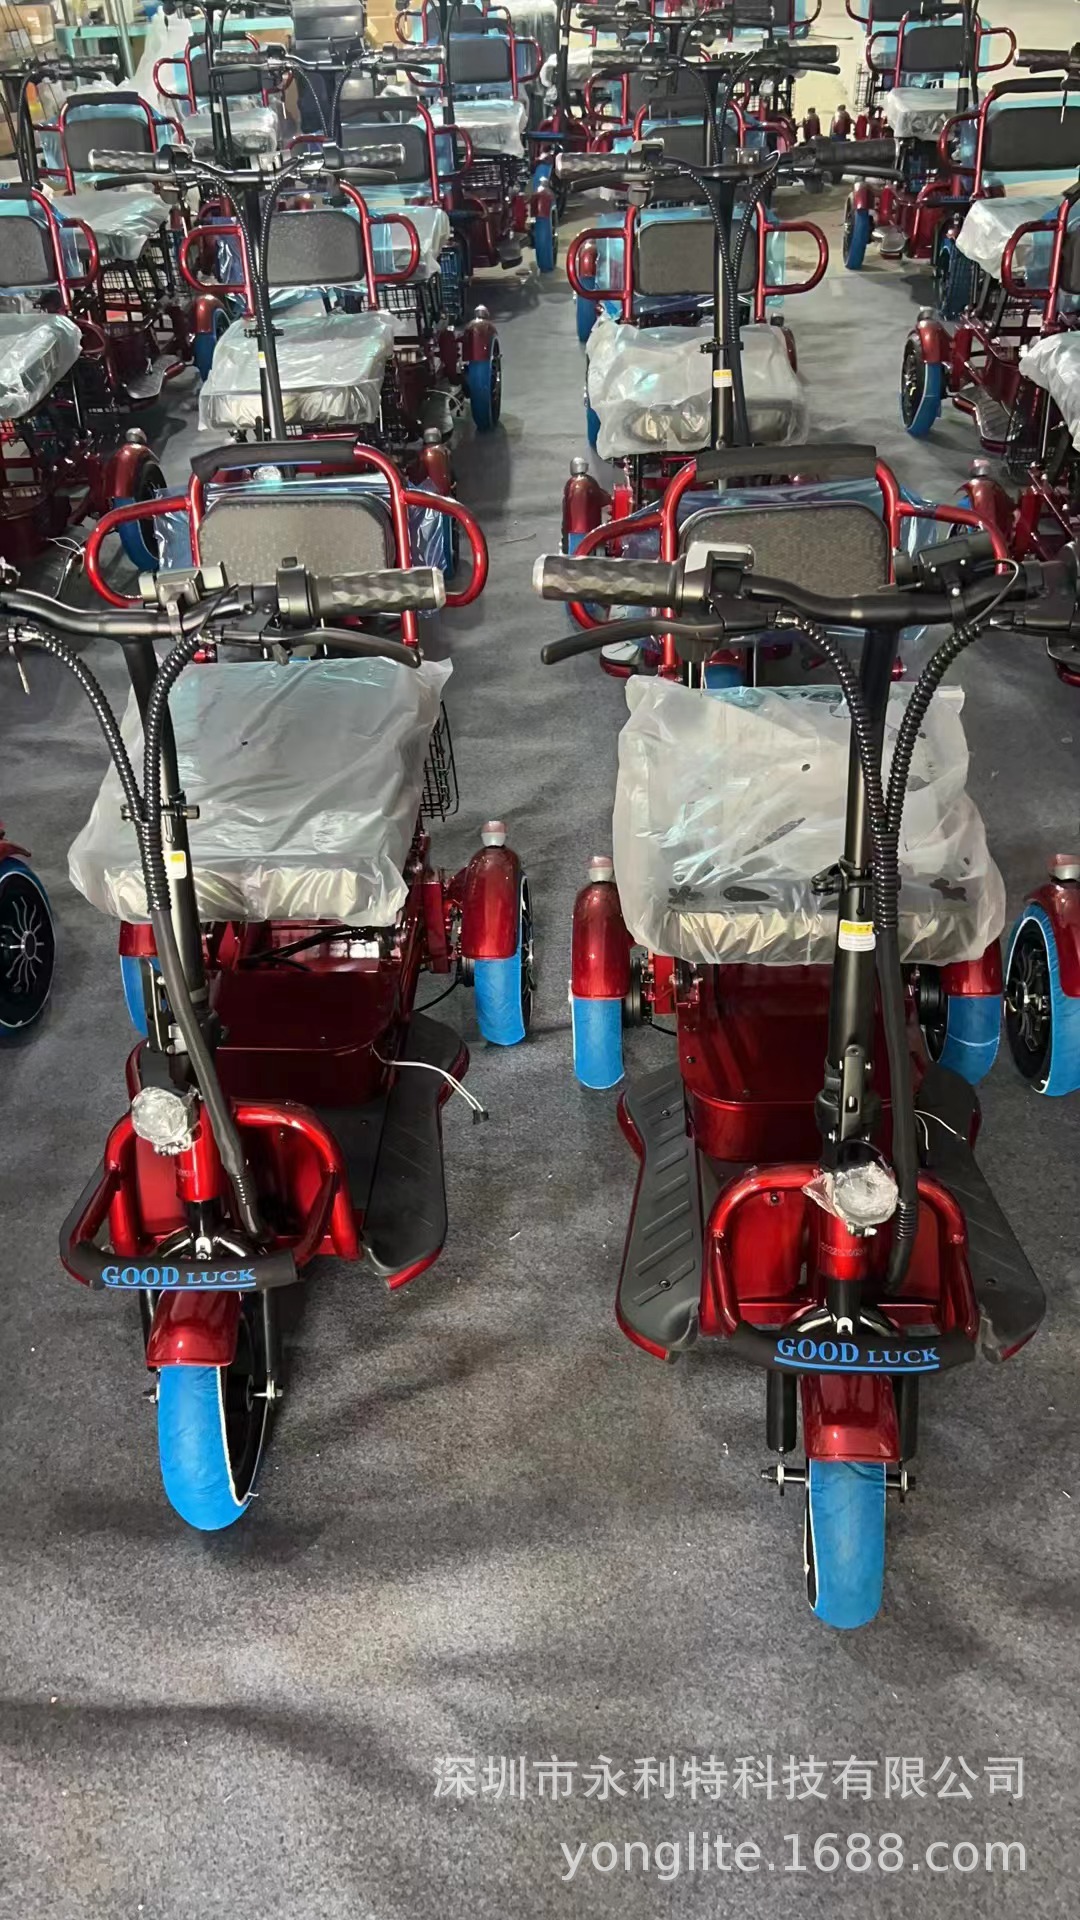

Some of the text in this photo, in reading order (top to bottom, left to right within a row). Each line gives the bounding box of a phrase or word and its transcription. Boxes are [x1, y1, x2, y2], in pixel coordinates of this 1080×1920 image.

[101, 1266, 257, 1286] GOOD LUCK
[777, 1338, 941, 1364] GOOD LUCK
